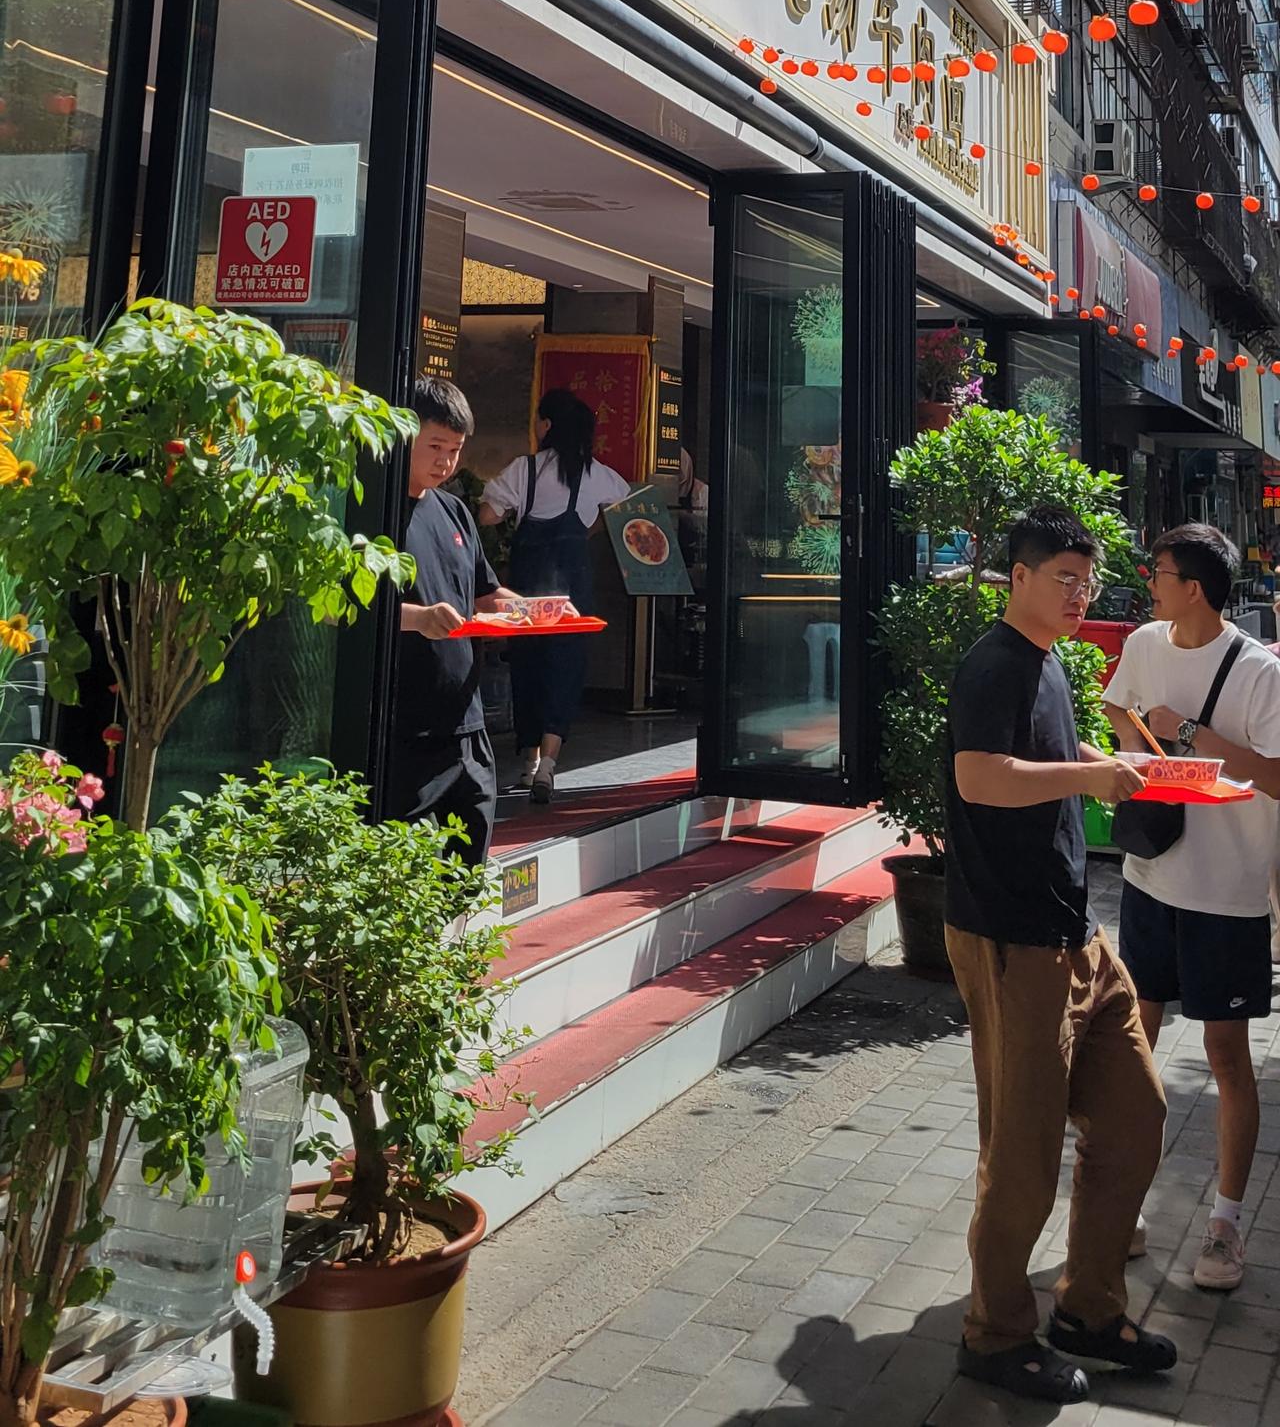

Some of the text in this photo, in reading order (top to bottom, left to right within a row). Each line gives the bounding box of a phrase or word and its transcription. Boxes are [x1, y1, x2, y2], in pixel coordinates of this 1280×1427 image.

[247, 201, 291, 220] AED
[227, 264, 301, 277] 店内配有AED
[221, 277, 305, 290] 紧急情况可破窗
